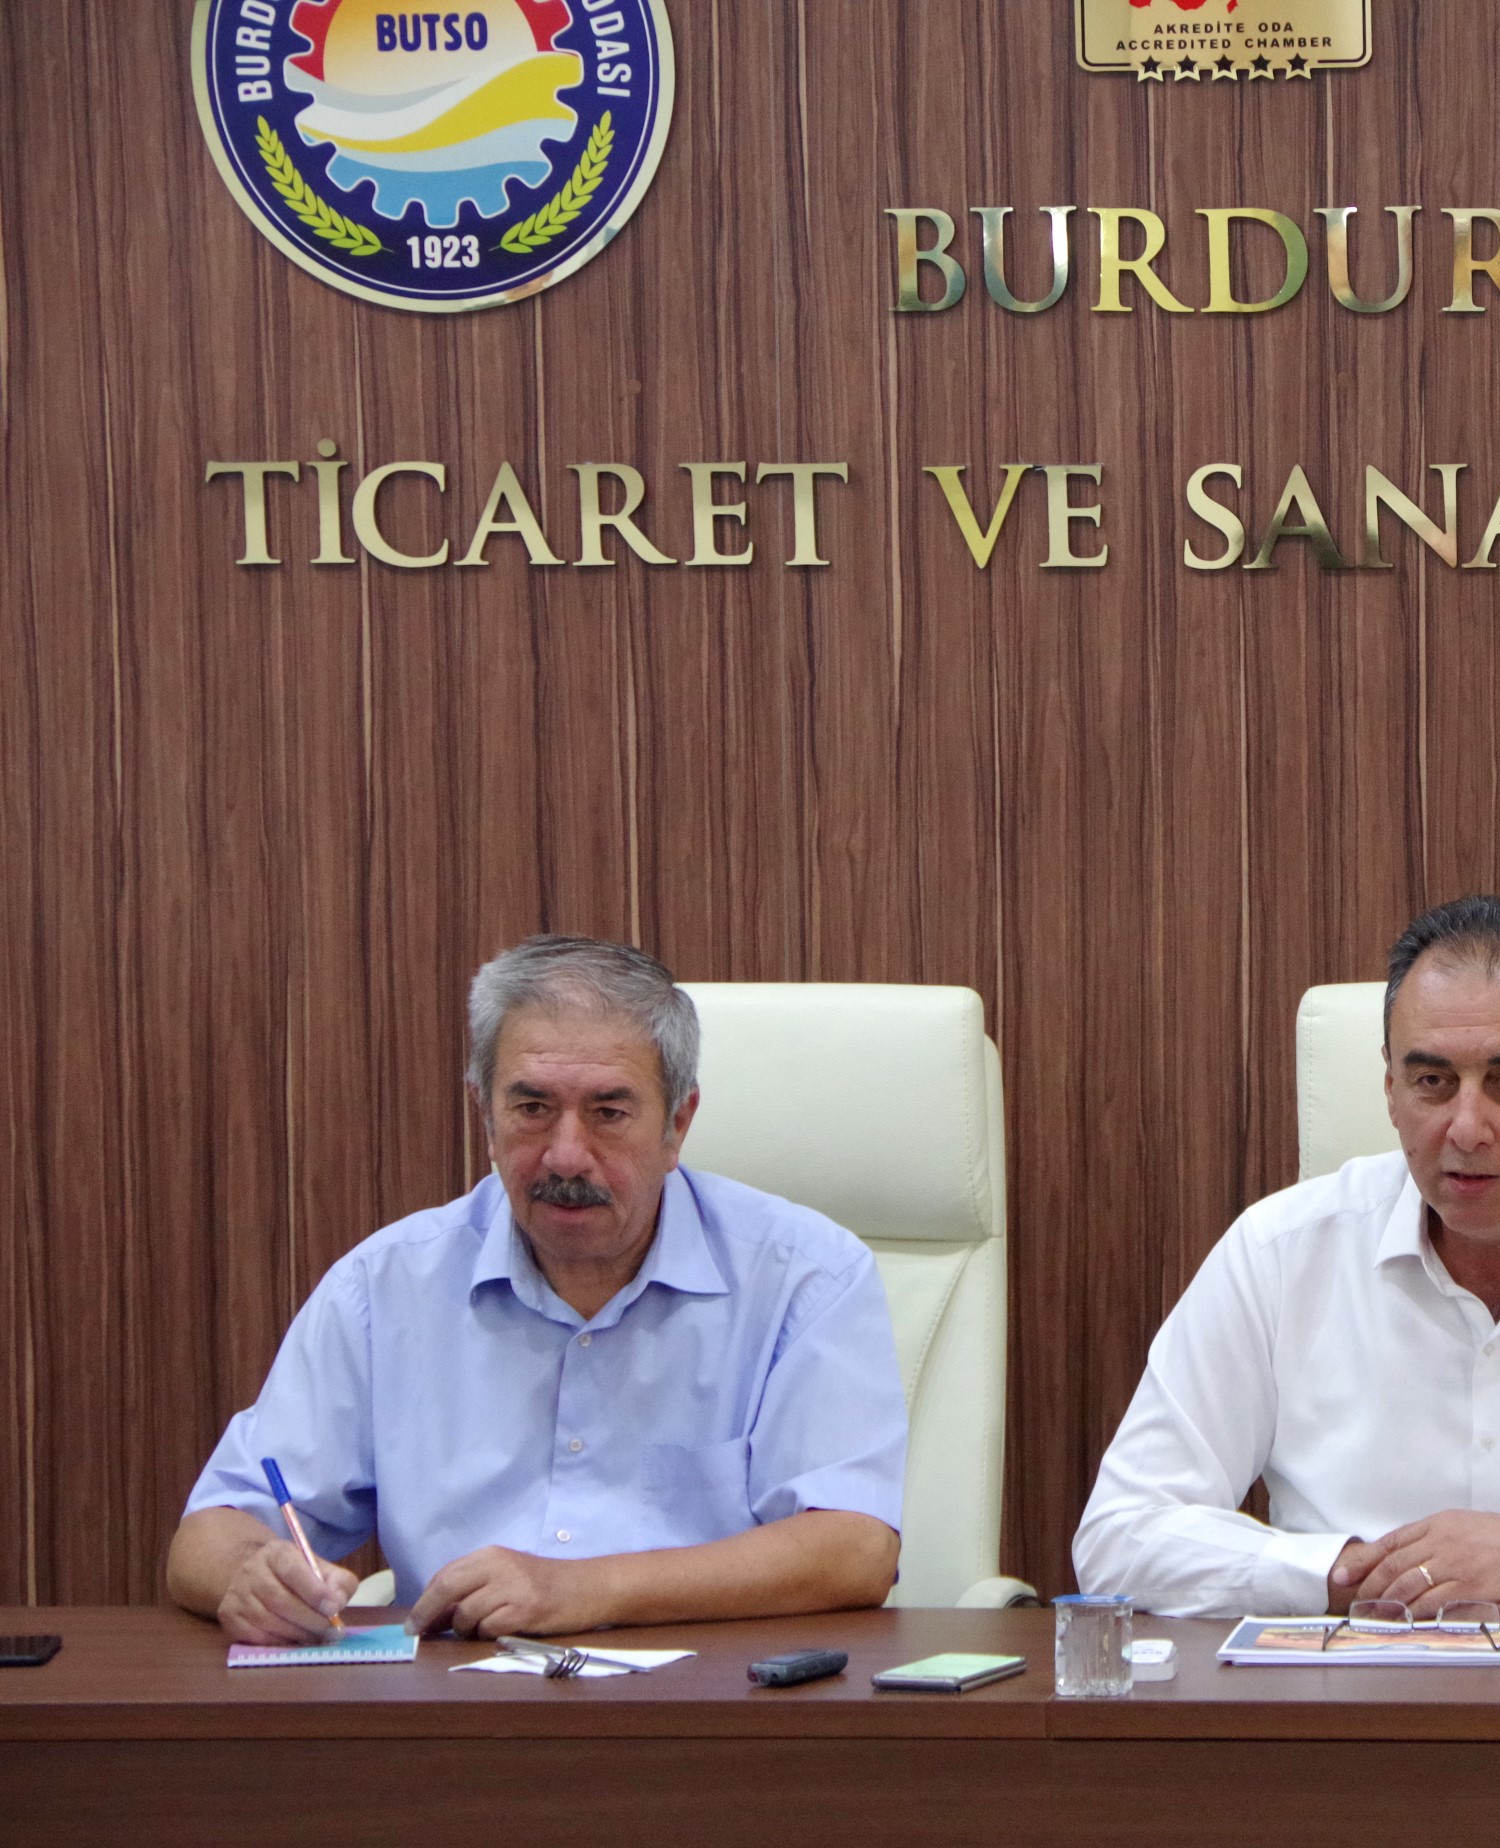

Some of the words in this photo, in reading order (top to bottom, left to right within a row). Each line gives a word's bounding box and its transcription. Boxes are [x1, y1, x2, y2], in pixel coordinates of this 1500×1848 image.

[376, 12, 488, 52] BUTSO
[1116, 38, 1231, 51] ACCREDITED
[1244, 36, 1332, 48] CHAMBER
[1153, 20, 1246, 35] AKREDİTE
[1258, 21, 1294, 33] ODA
[235, 0, 281, 102] BURD
[406, 235, 480, 269] 1923
[204, 438, 849, 568] TİCARET
[922, 462, 1109, 570] VE
